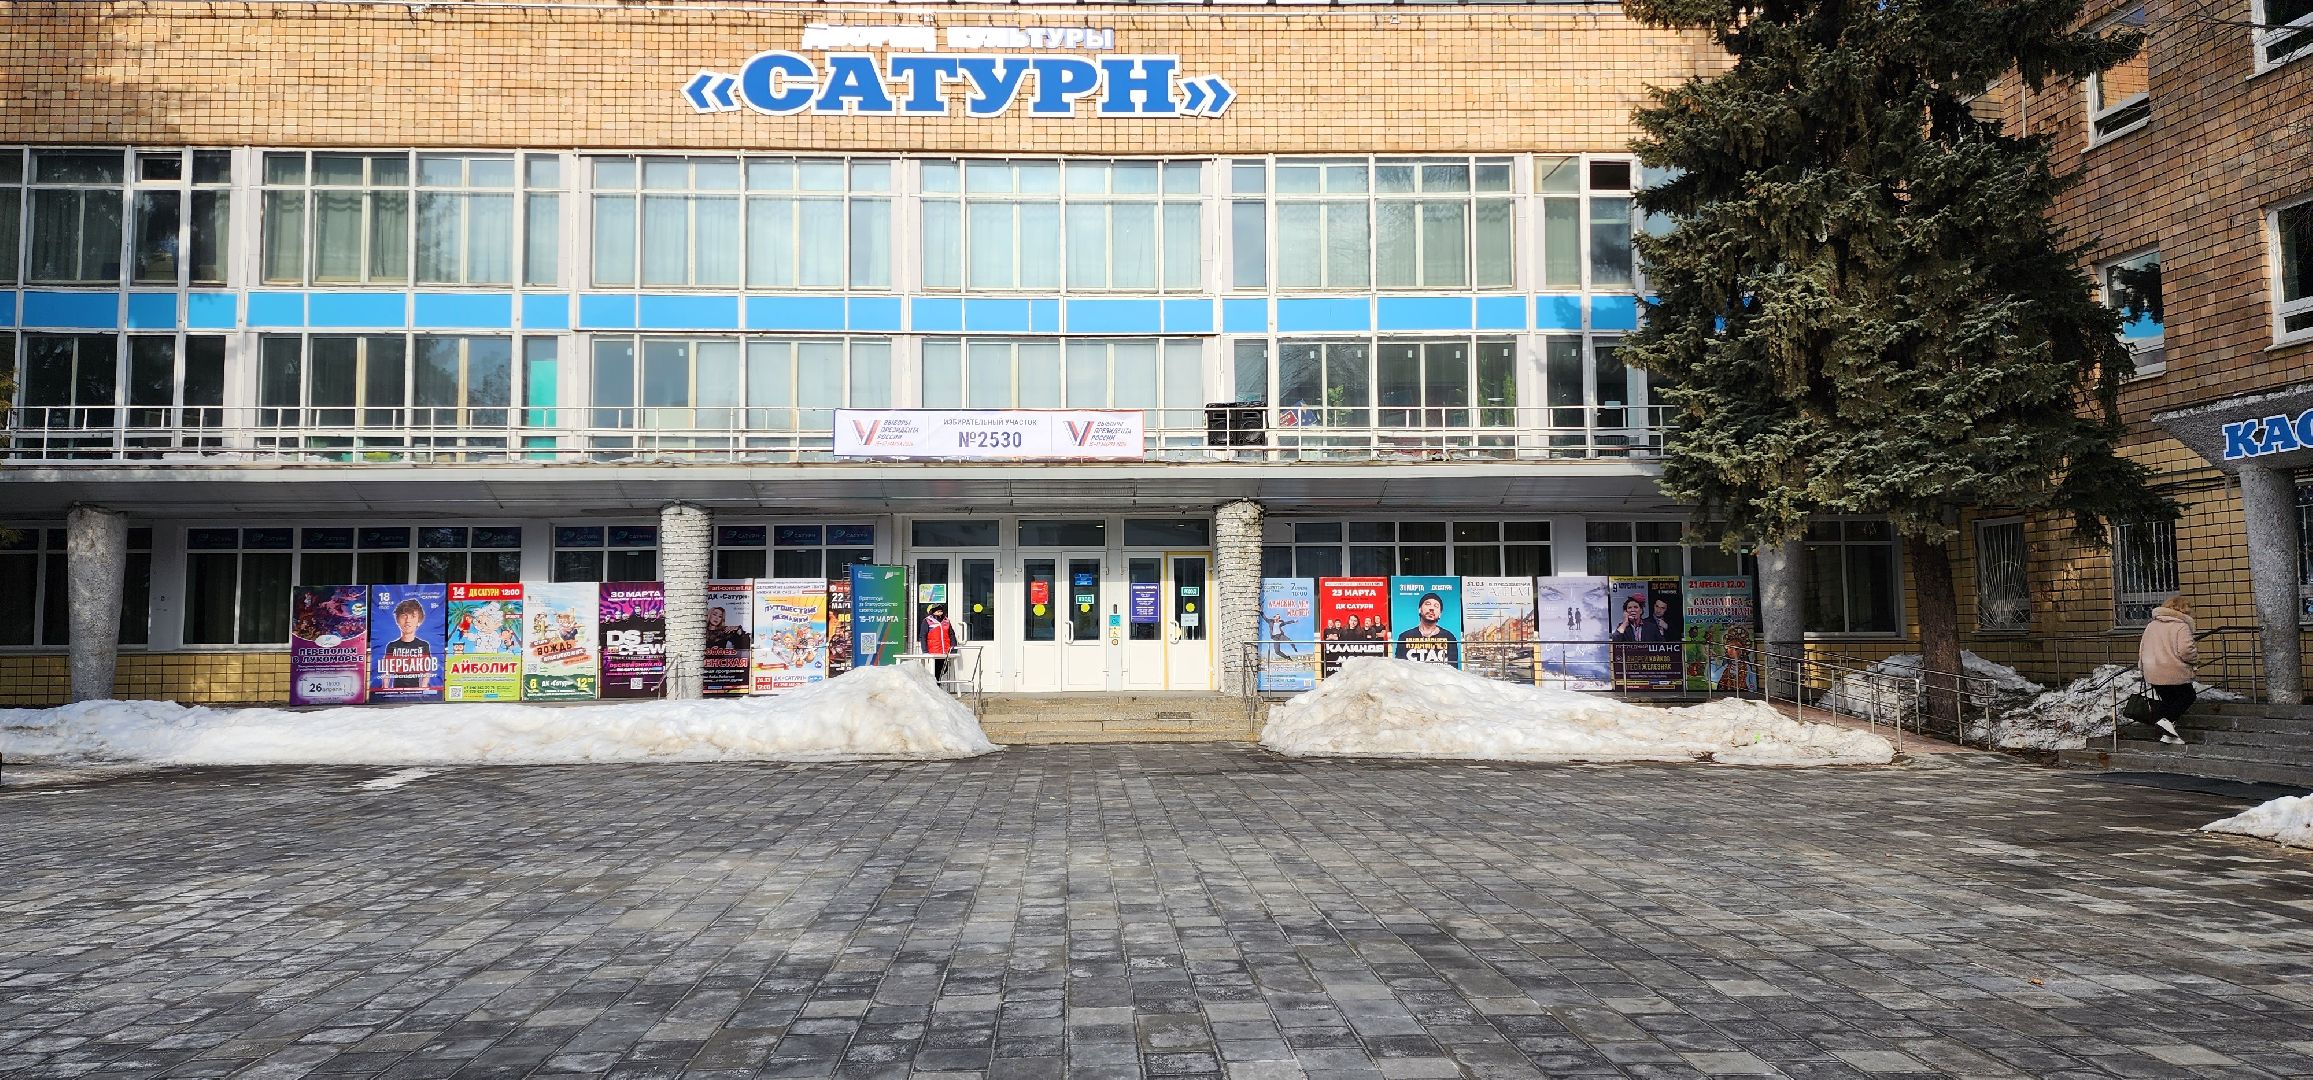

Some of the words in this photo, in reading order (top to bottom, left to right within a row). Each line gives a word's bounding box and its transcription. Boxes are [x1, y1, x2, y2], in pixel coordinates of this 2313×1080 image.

[944, 417, 1004, 426] ИЗБИРАТЕЛЬНЫЙ
[1005, 418, 1037, 426] УЧАСТОК
[958, 431, 1022, 448] №2530
[452, 586, 465, 596] 14
[501, 588, 520, 596] 12:00
[1612, 582, 1618, 593] 9
[378, 592, 390, 601] 18
[625, 590, 661, 598] МАРТА
[831, 592, 844, 602] 22
[1344, 589, 1377, 597] МАРТА
[606, 629, 641, 648] DS
[299, 647, 358, 656] ПЕРЕПОЛОХ
[392, 646, 424, 658] АЛЕКСЕЙ
[536, 641, 573, 656] ВОЖДЬ
[618, 642, 666, 656] CREW
[1648, 644, 1680, 652] ШАНС
[302, 655, 365, 664] ЛУКОМОРЬЕ
[1405, 648, 1448, 663] СТАС
[377, 656, 439, 675] ЩЕРБАКОВ
[450, 659, 519, 674] АЙБОЛИТ
[308, 682, 323, 693] 26
